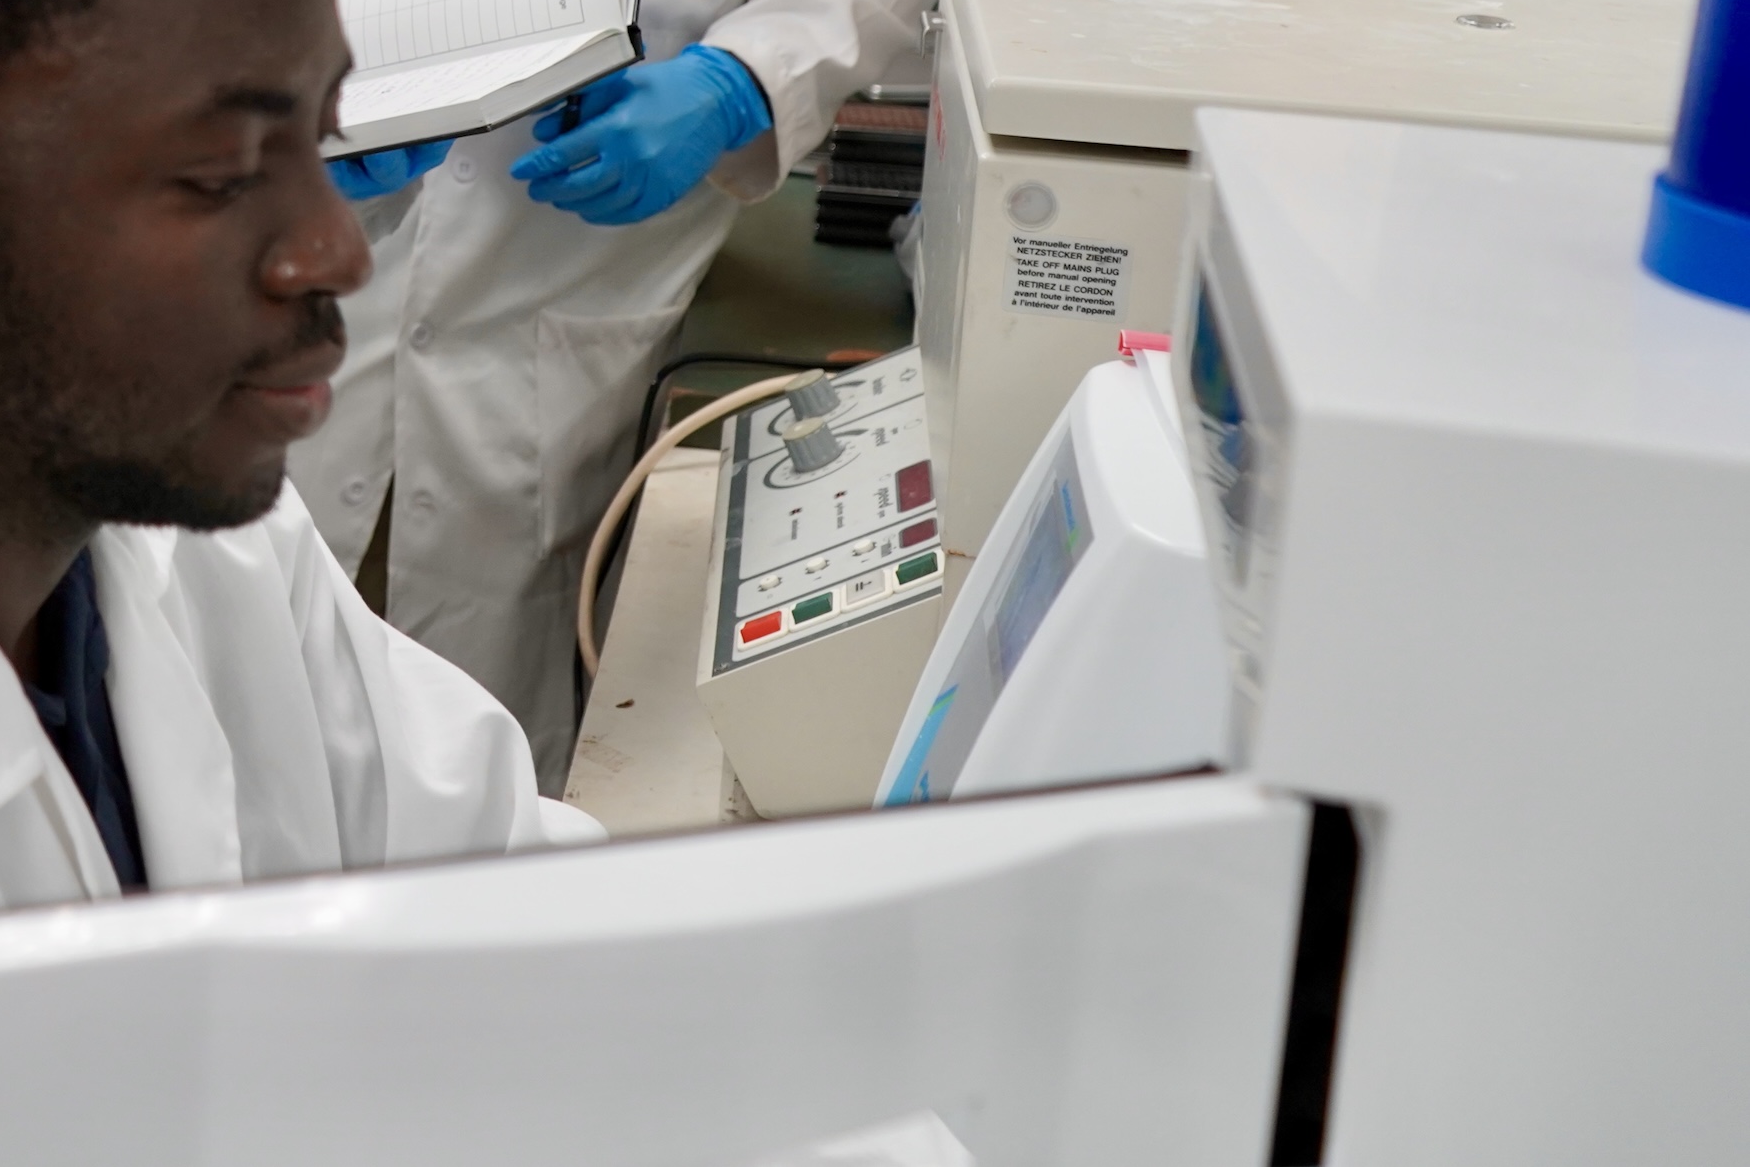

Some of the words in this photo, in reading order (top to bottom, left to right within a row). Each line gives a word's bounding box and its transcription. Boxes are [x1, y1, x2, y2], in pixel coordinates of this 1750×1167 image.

[1013, 236, 1027, 245] Vor
[1029, 239, 1071, 249] manueller
[1074, 242, 1129, 256] Entriegelung
[1016, 247, 1083, 260] NETZSTECKER
[1086, 254, 1122, 264] ZIEHEN!
[1016, 258, 1039, 267] TAKE
[1042, 261, 1060, 269] OFF
[1063, 263, 1092, 273] MAINS
[1095, 267, 1120, 276] PLUG
[1017, 268, 1045, 278] before
[1048, 272, 1079, 281] manual
[1082, 276, 1117, 287] opening
[1018, 280, 1056, 291] RETIREZ
[1059, 284, 1070, 292] LE
[1073, 286, 1114, 296] CORDON
[1011, 298, 1017, 306] à
[1020, 299, 1060, 310] l'intérieur
[1062, 303, 1073, 312] de
[1076, 305, 1116, 316] l'appareil
[1014, 290, 1037, 298] avant
[1040, 292, 1062, 301] toute
[1065, 295, 1115, 306] intervention
[873, 487, 893, 509] speed
